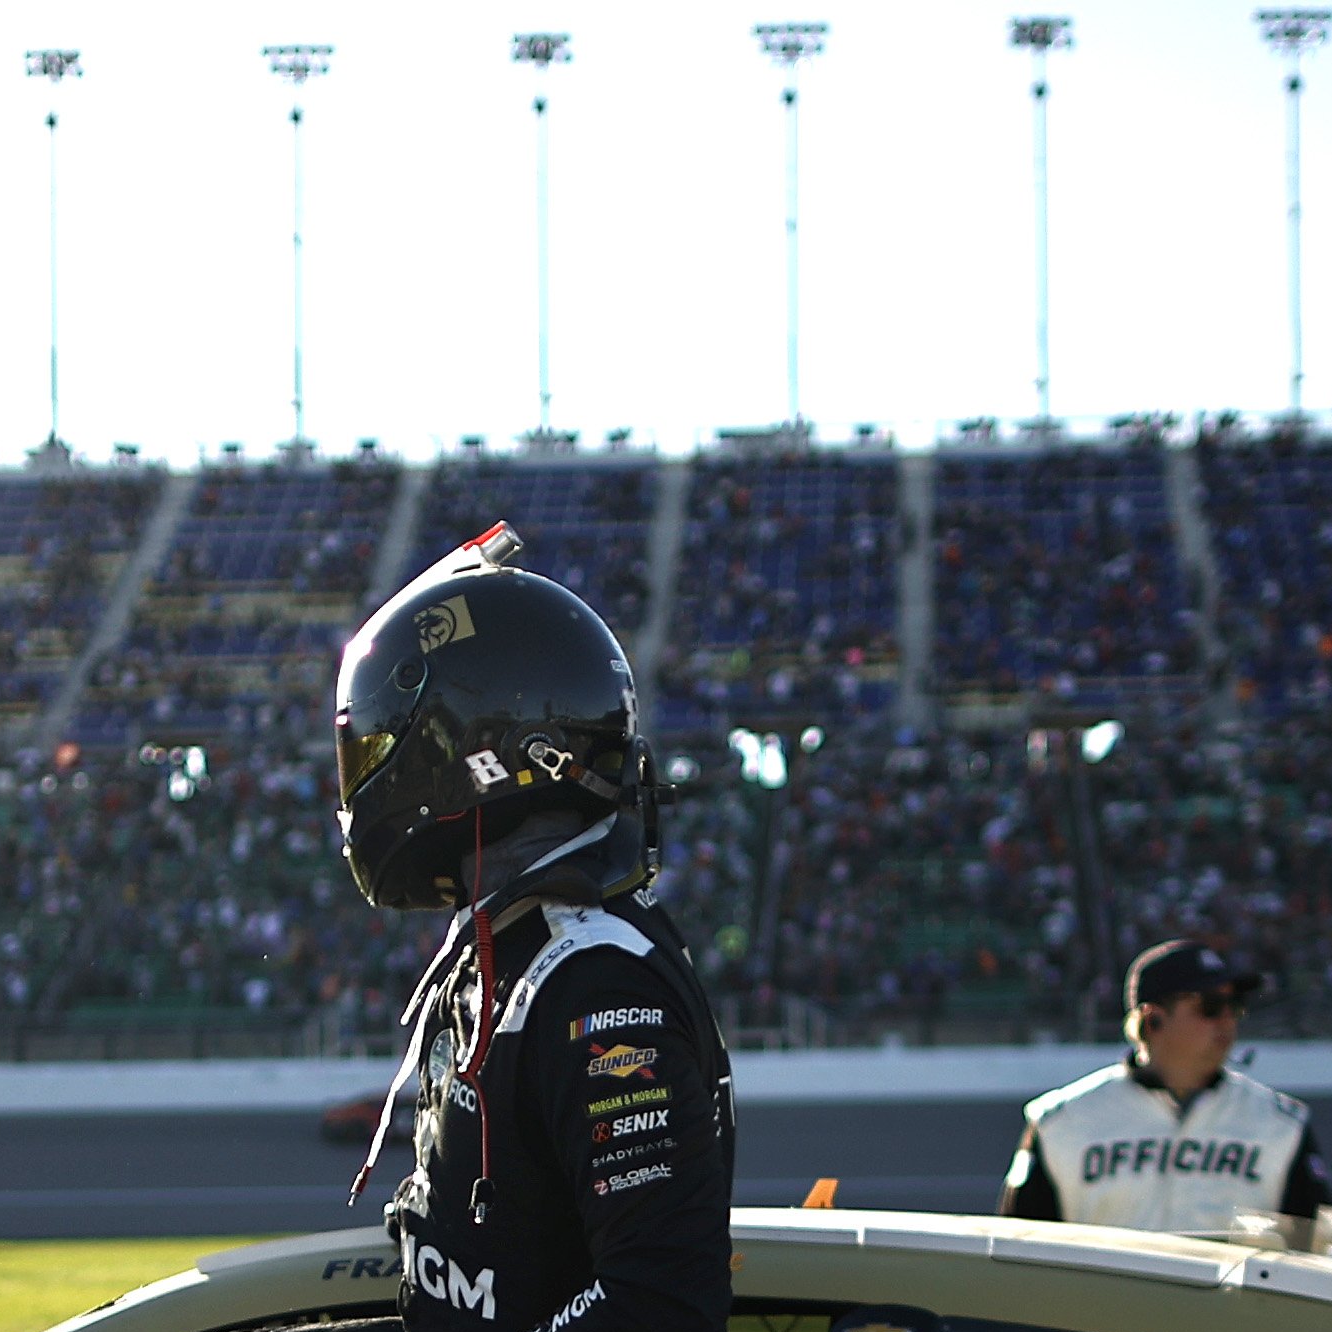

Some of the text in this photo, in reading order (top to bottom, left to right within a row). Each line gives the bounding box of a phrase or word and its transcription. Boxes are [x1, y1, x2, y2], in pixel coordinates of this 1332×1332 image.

[465, 749, 510, 785] 8
[590, 1007, 664, 1032] NASCAR
[589, 1048, 656, 1075] SUNOCO
[587, 1094, 623, 1115] MORGAN
[631, 1087, 668, 1105] MORGAN
[611, 1109, 670, 1137] SENIX
[608, 1162, 672, 1186] GLOBAL
[1083, 1139, 1262, 1183] OFFICIAL
